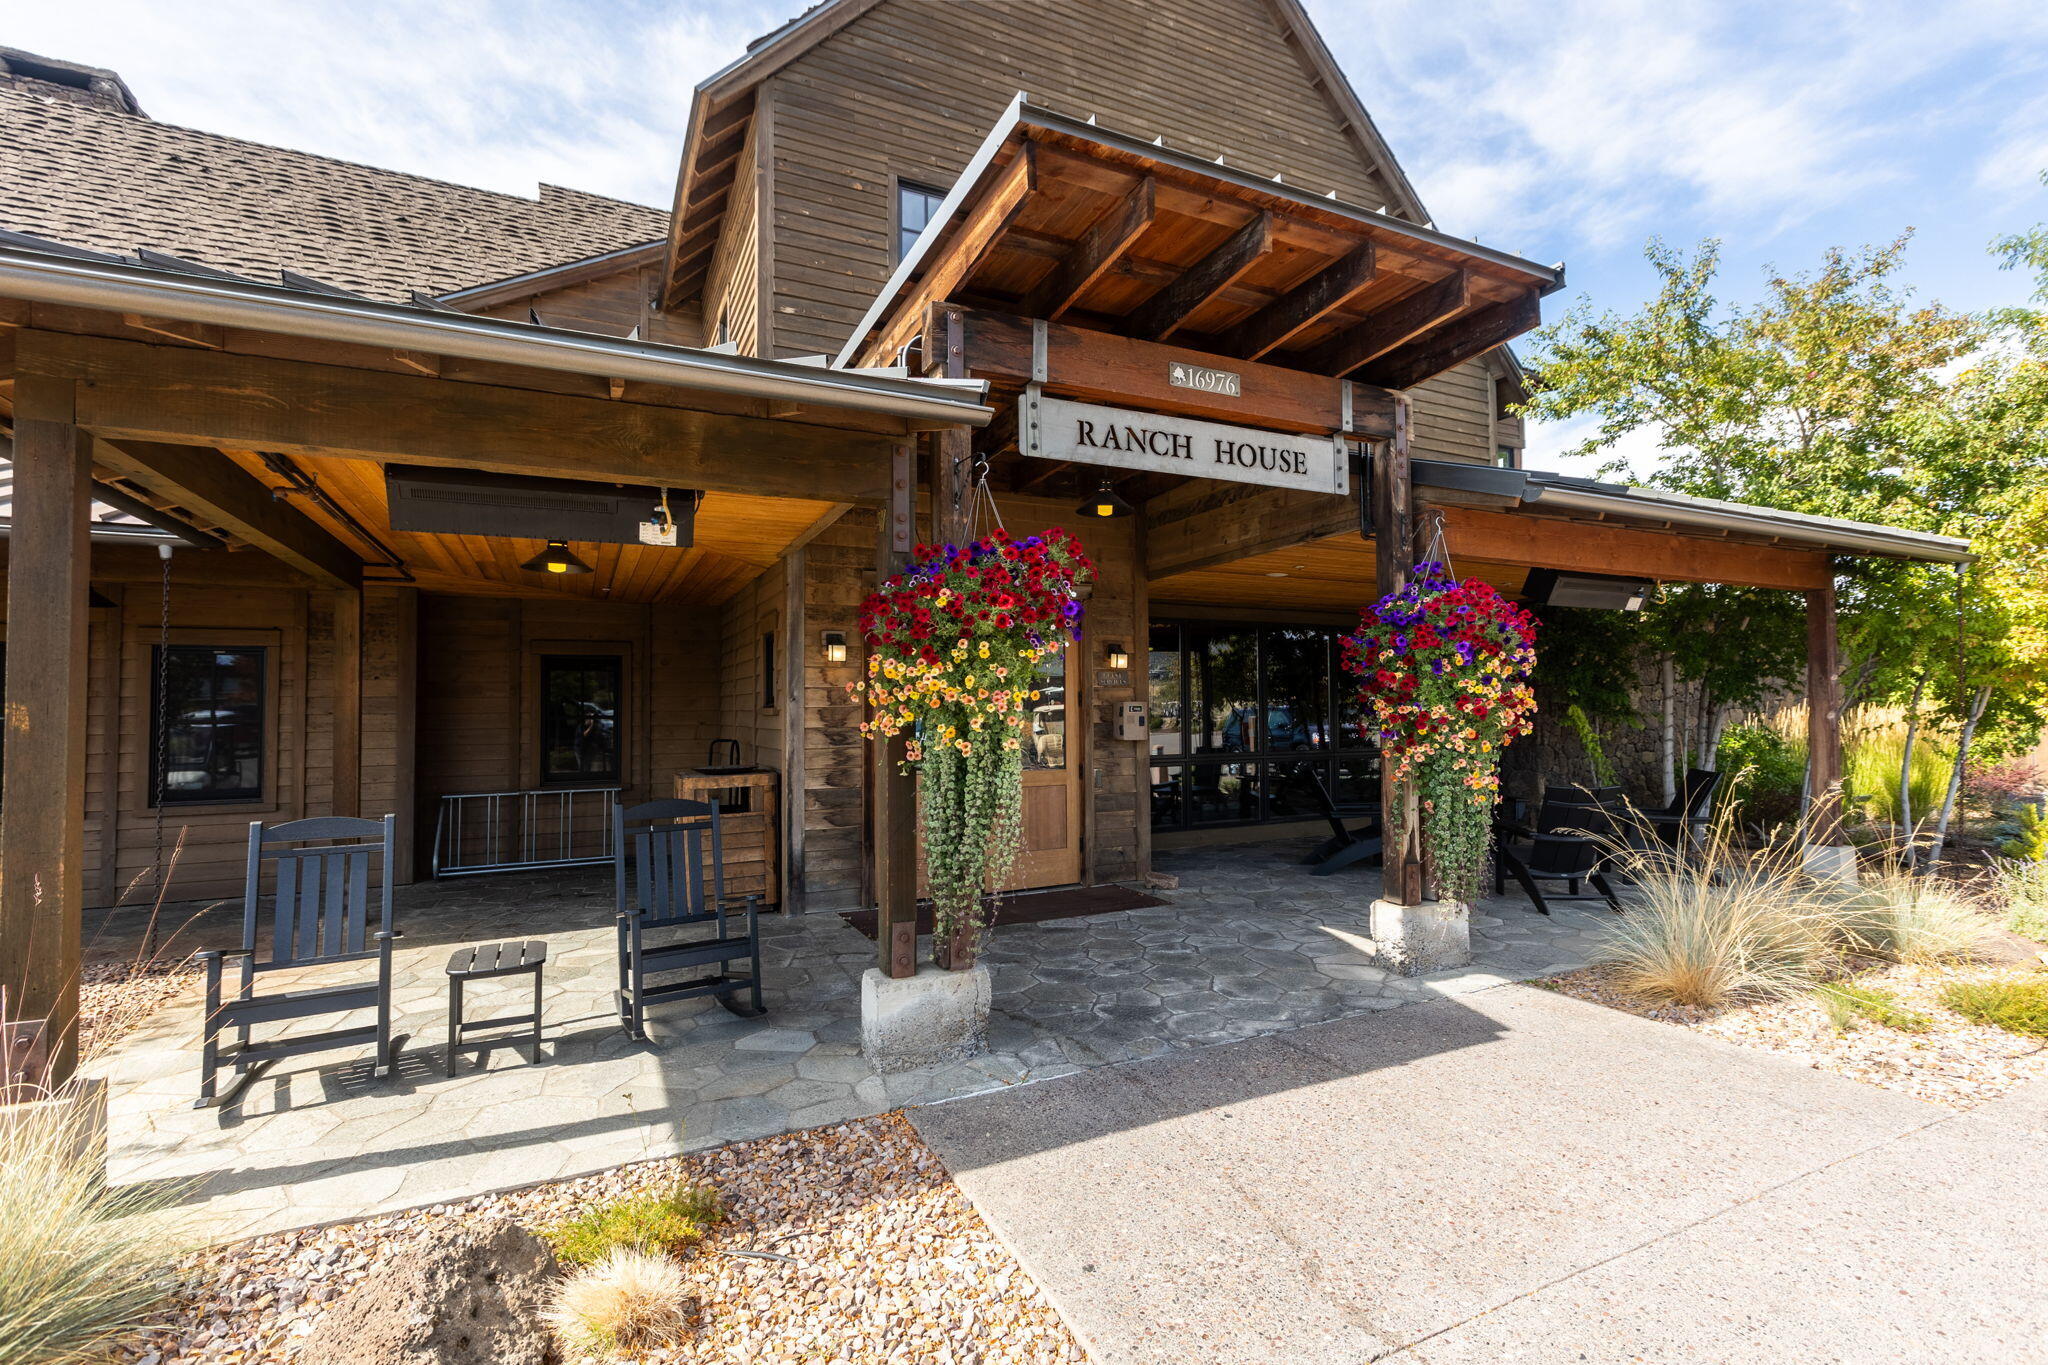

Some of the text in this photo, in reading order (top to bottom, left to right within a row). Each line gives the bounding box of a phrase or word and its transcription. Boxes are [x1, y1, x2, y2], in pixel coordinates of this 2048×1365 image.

[1187, 367, 1236, 394] 16976
[1076, 419, 1308, 475] RANCH HOUSE
